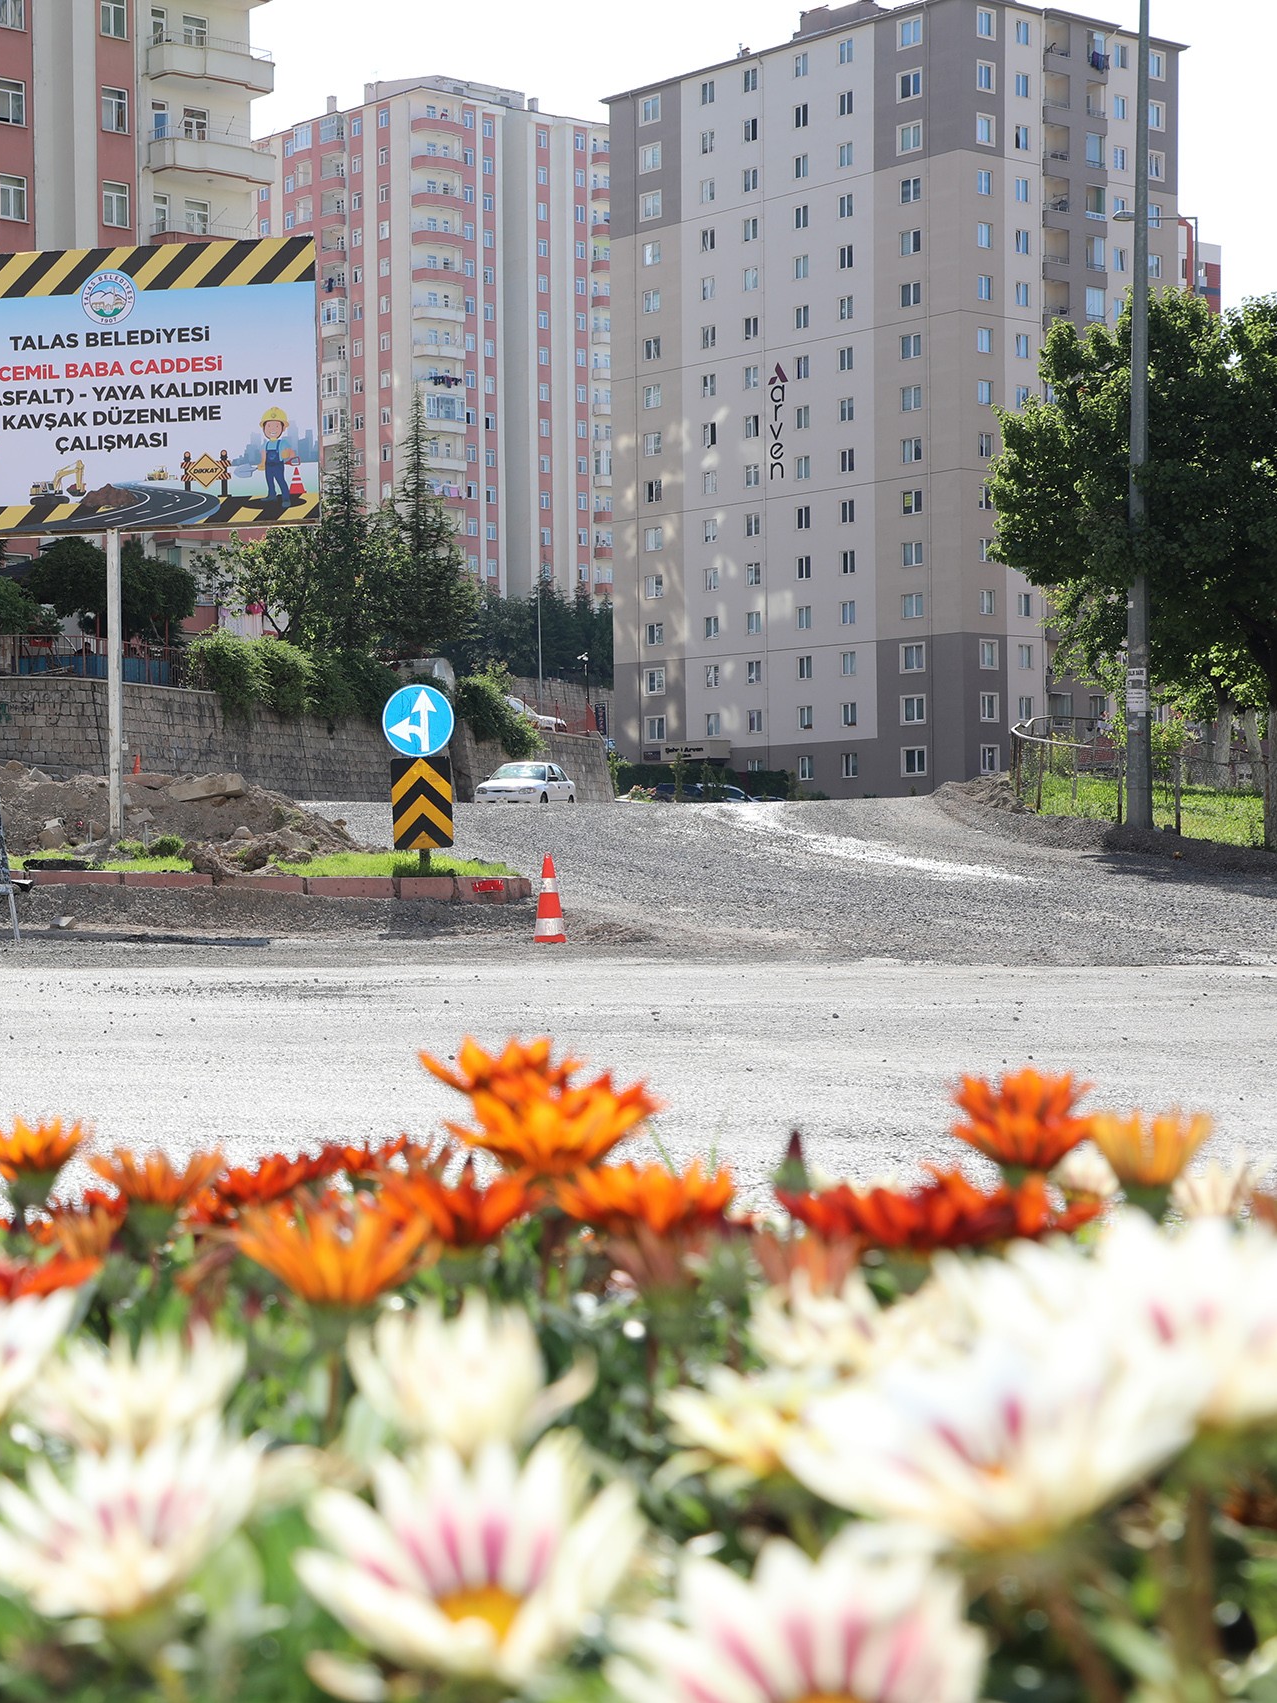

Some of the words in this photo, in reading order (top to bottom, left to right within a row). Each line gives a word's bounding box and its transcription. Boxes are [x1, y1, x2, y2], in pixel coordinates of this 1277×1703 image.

[9, 333, 79, 351] TALAS
[65, 361, 125, 379] BABA
[92, 384, 145, 402] YAYA
[151, 378, 258, 399] KALDIRIMI
[264, 376, 293, 393] VE
[2, 411, 88, 431] KAVŞAK
[92, 405, 222, 426] DÜZENLEME
[55, 432, 168, 455] ÇALIŞMASI
